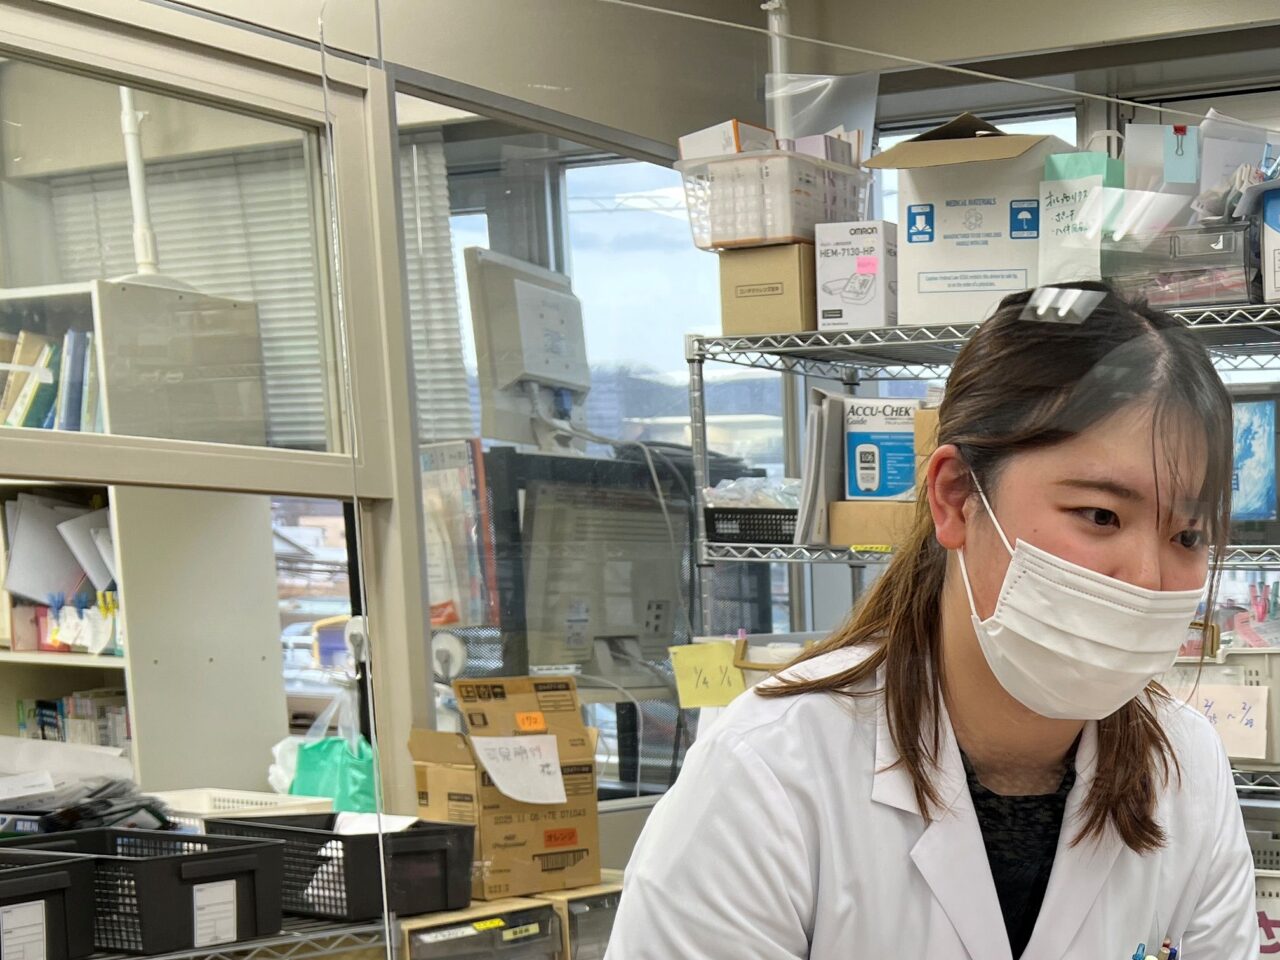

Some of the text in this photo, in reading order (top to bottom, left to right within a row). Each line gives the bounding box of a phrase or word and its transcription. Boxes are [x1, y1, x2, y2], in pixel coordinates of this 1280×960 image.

[849, 226, 877, 236] OMRON
[819, 247, 875, 258] HEM-7130-HP
[847, 405, 911, 417] ACCU-CHEK
